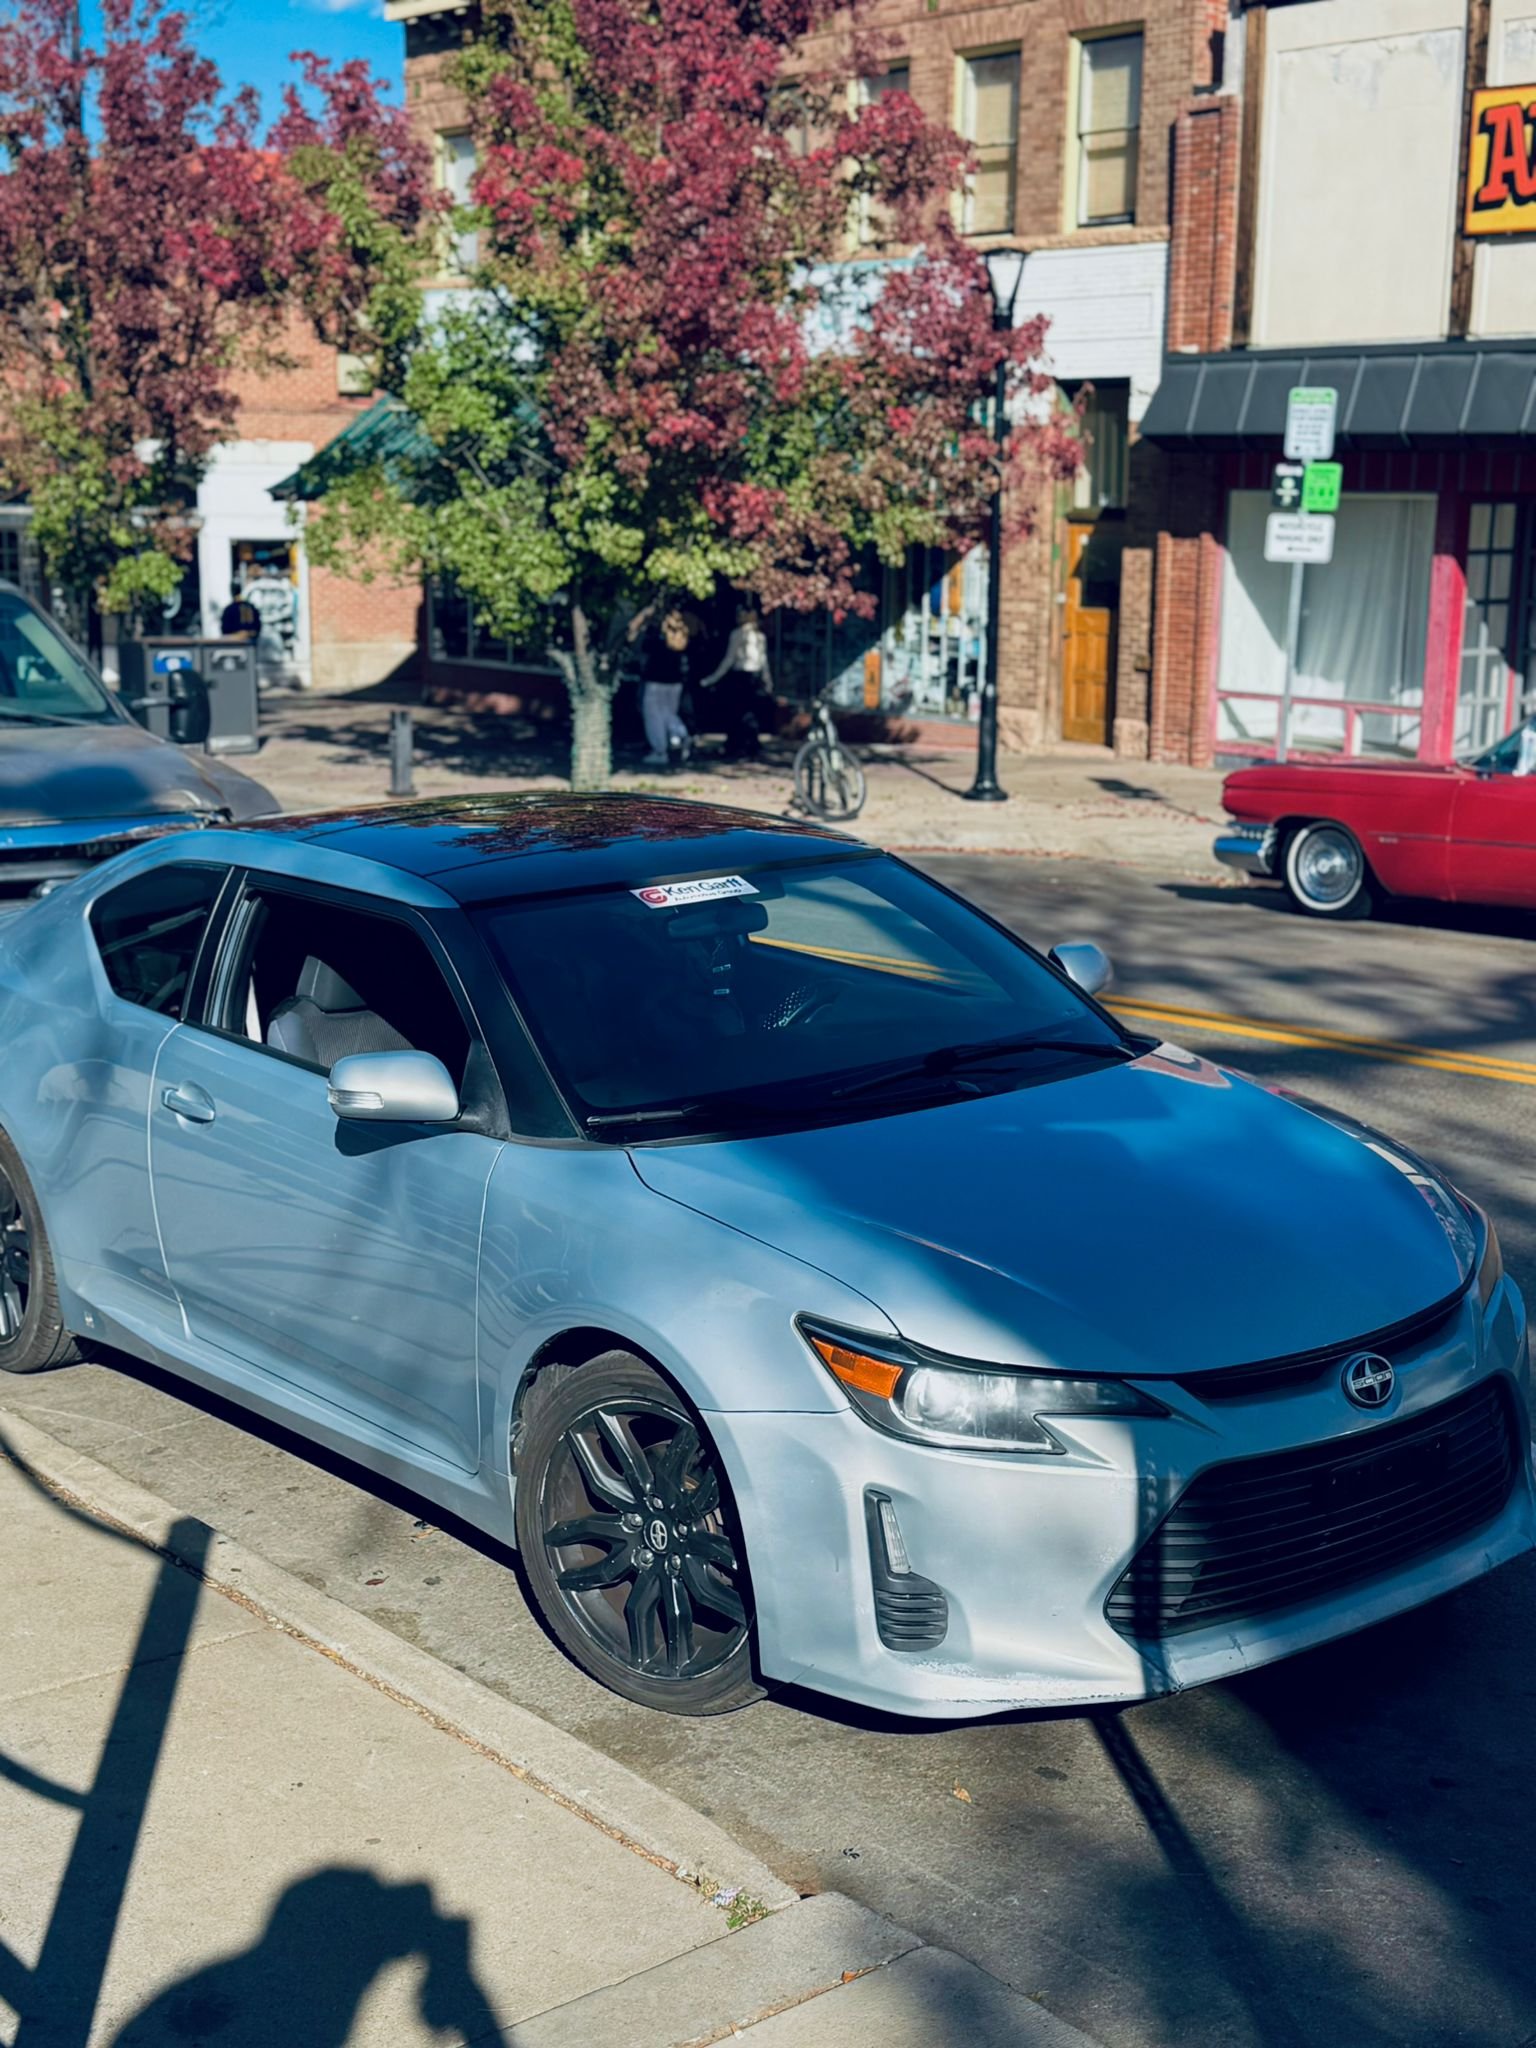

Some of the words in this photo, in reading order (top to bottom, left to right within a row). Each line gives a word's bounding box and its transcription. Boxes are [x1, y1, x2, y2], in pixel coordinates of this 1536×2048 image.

[1474, 102, 1536, 210] A
[662, 885, 699, 896] Ken
[699, 878, 742, 891] Garff
